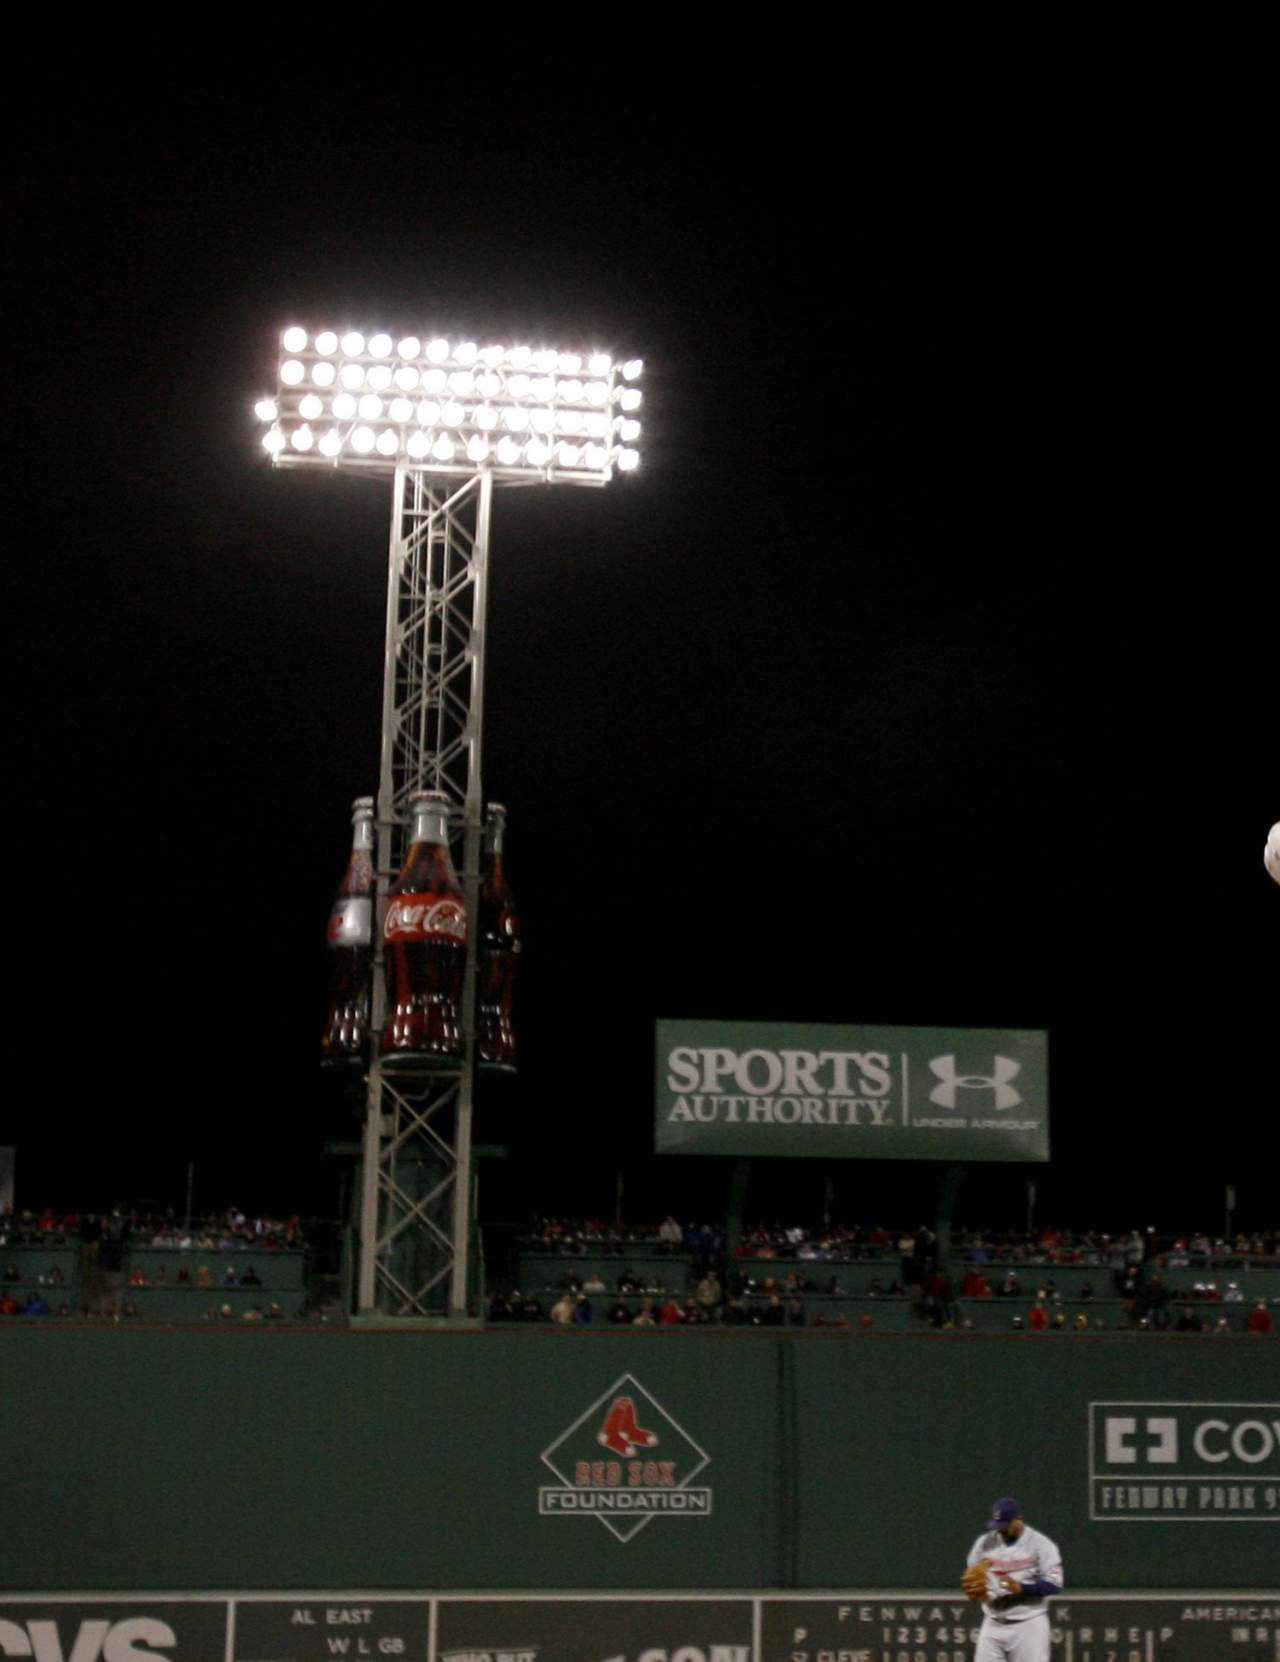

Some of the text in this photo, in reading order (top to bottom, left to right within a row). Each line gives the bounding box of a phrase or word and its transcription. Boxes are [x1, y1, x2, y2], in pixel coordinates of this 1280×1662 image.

[667, 1046, 892, 1098] SPORTS
[667, 1095, 891, 1126] AUTHORITY
[912, 1118, 967, 1129] UNDER
[575, 1461, 676, 1486] RED SOX
[546, 1493, 705, 1509] FOUNDATION
[1101, 1486, 1188, 1509] FENWAY
[1199, 1487, 1256, 1510] PARK
[291, 1608, 374, 1624] AL EAST
[838, 1606, 964, 1621] FENWAY
[328, 1637, 405, 1654] W L GB
